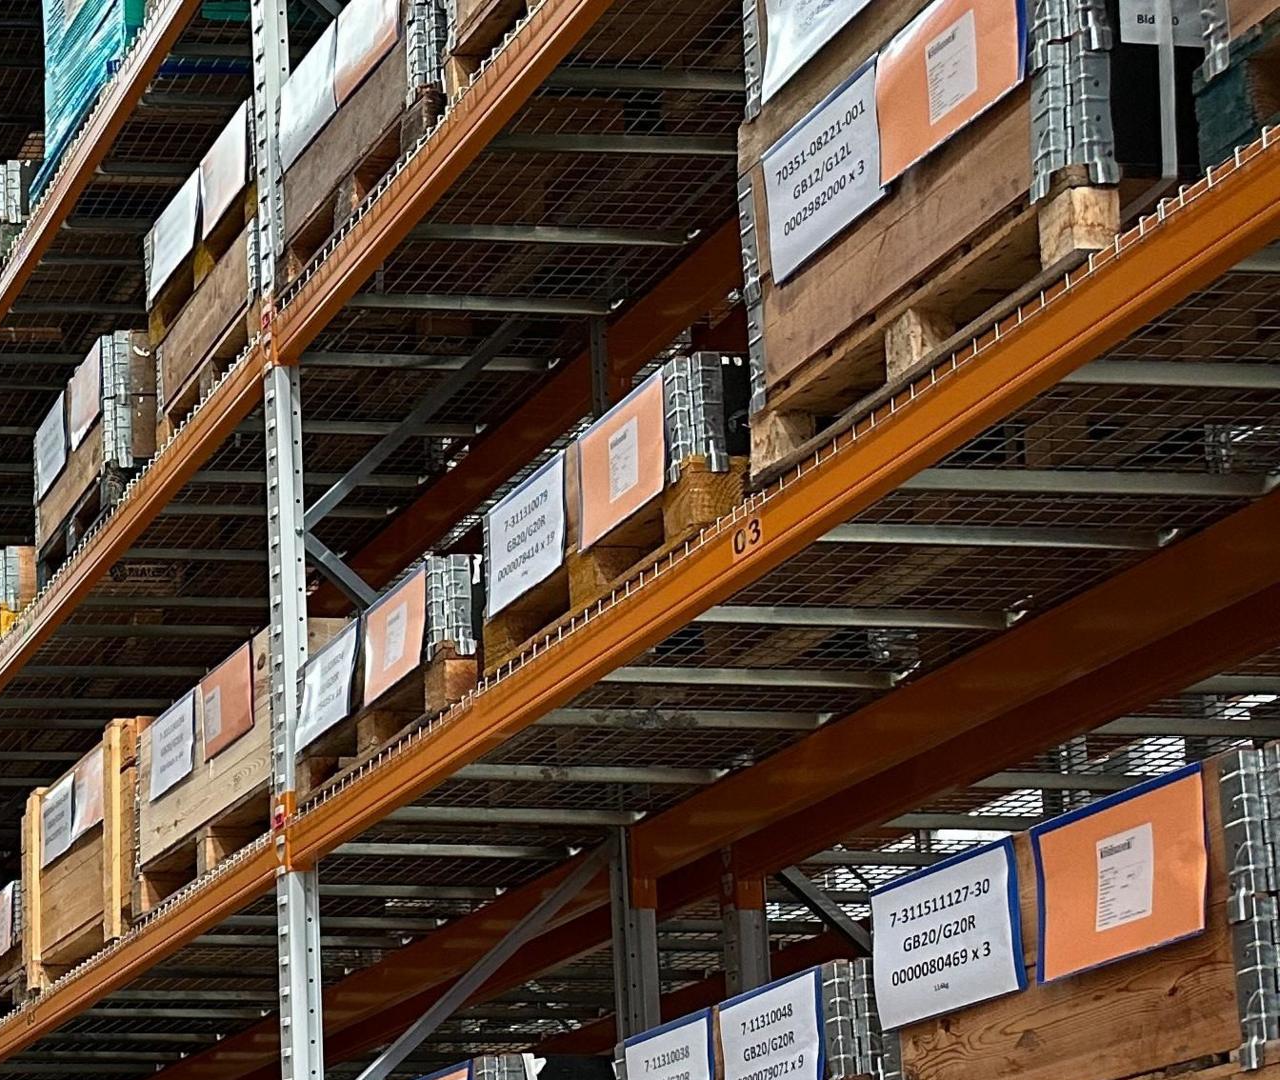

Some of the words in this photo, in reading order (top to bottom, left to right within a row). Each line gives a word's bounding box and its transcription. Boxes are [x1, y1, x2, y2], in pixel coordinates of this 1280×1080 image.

[775, 99, 866, 186] 70351-08221-001
[793, 142, 852, 200] GB12/G12L
[784, 174, 846, 236] 0002982000
[848, 170, 856, 184] x
[857, 160, 865, 175] 3
[734, 518, 761, 554] 03
[889, 878, 990, 928] 7-311511127-30
[903, 915, 976, 952] GB20/G20R
[891, 948, 968, 986] 0000080469
[971, 948, 979, 961] x
[983, 941, 991, 957] 3
[741, 1002, 793, 1036] 7-11310048
[644, 1045, 690, 1072] 7-11310038
[743, 1031, 795, 1062] GB20/G20R
[790, 1060, 797, 1071] x
[798, 1054, 804, 1069] 9
